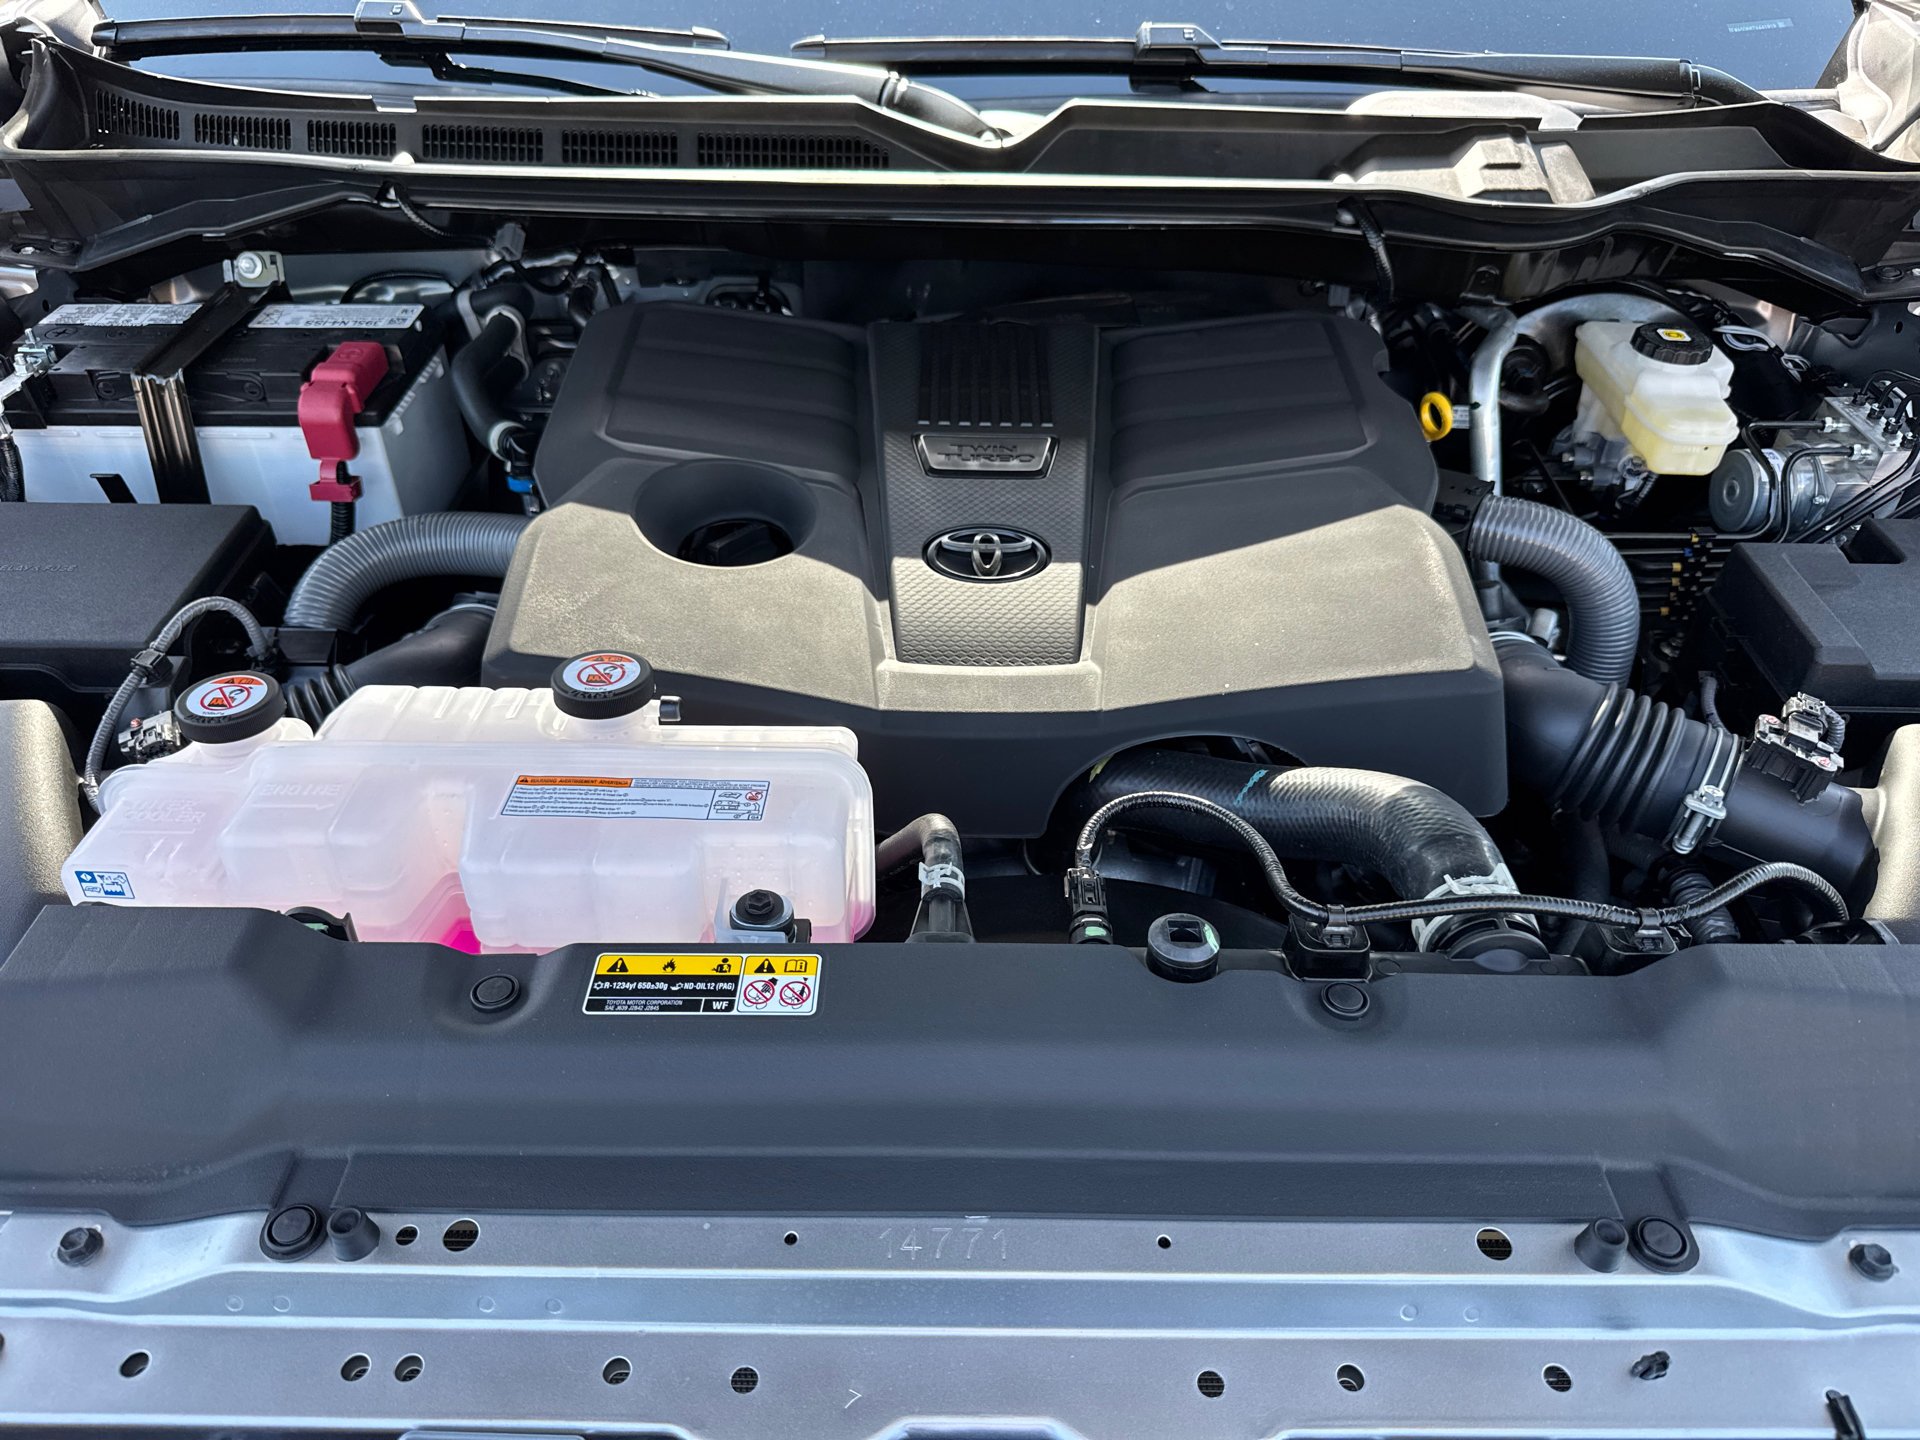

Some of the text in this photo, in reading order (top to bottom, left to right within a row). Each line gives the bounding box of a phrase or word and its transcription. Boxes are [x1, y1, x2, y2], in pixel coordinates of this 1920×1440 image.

[950, 444, 1017, 452] TWIN
[937, 452, 1035, 462] TURBO
[260, 783, 343, 796] ENGINE
[124, 810, 206, 824] COOLER
[604, 982, 636, 991] R-1234yf
[637, 982, 668, 991] 650±30g
[716, 982, 735, 991] (PAG)
[712, 1001, 729, 1010] WF
[879, 1227, 1006, 1260] 14771
